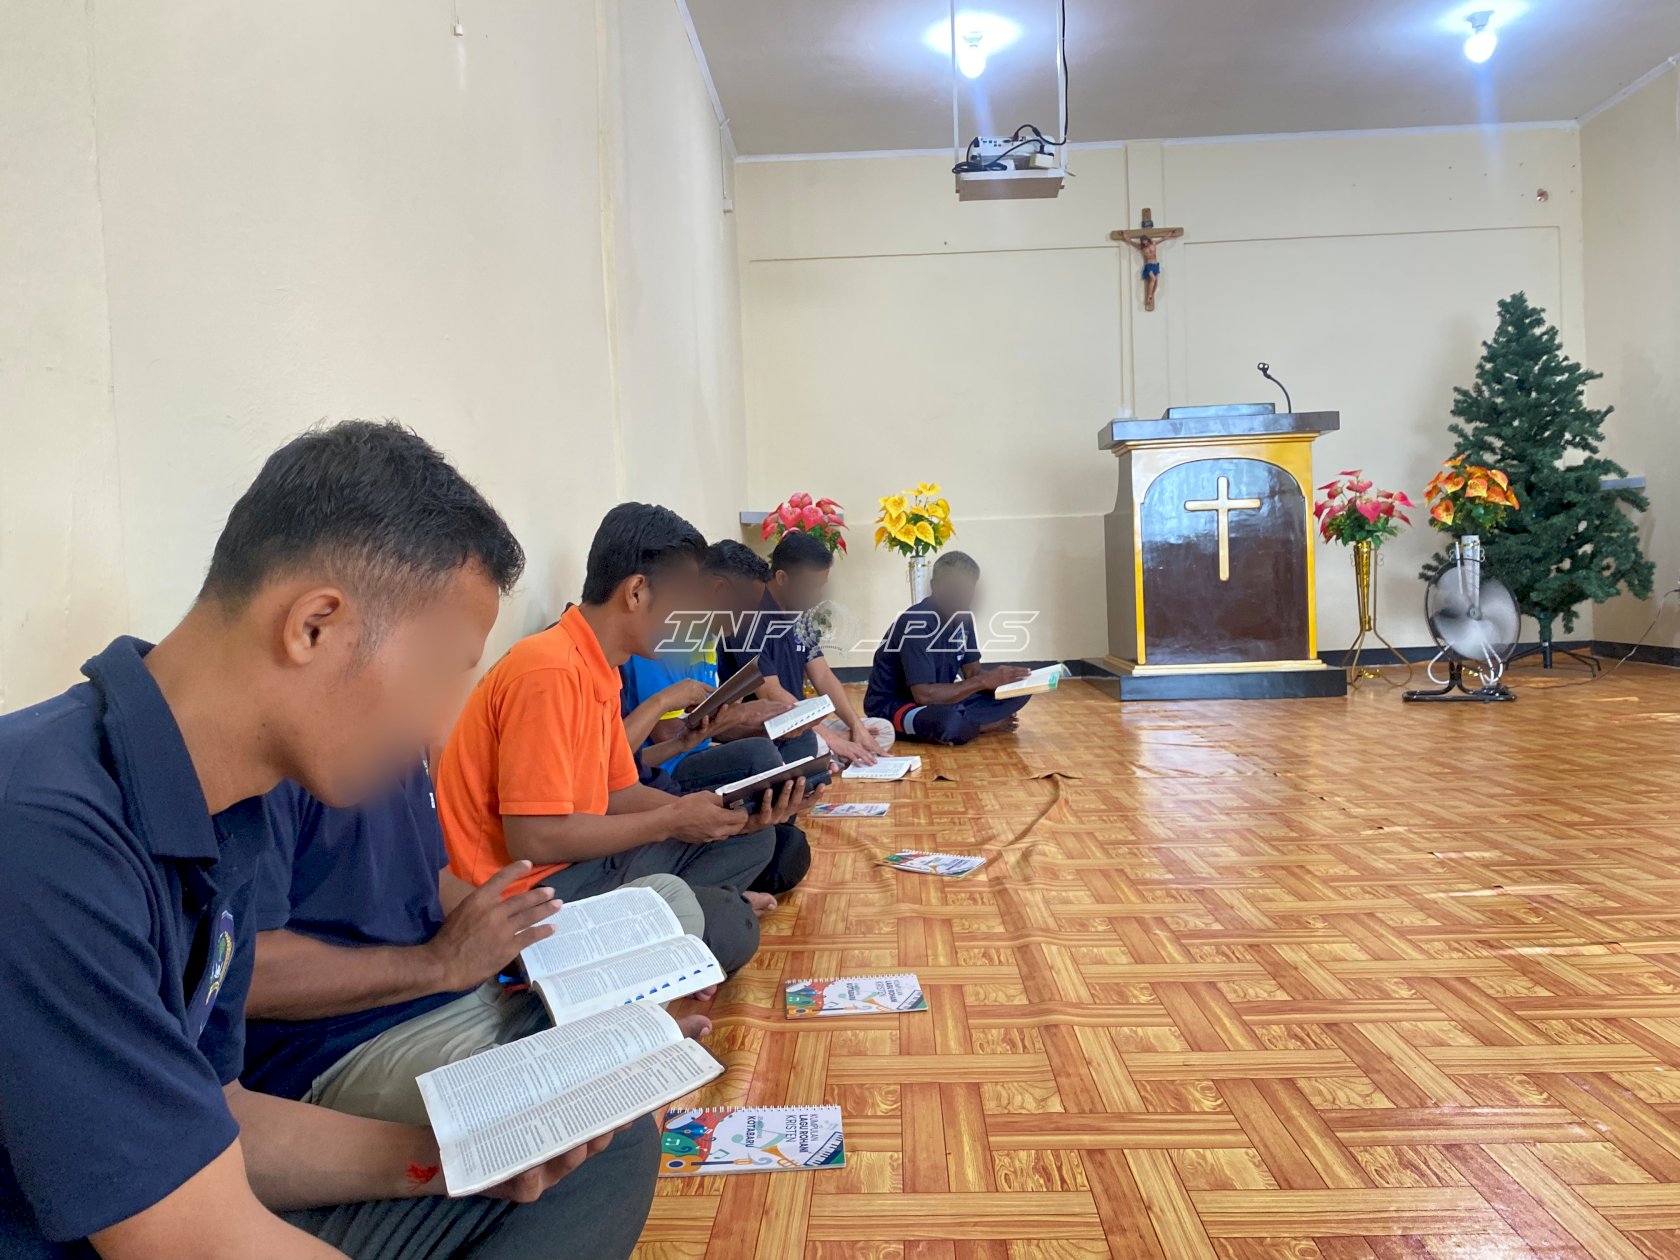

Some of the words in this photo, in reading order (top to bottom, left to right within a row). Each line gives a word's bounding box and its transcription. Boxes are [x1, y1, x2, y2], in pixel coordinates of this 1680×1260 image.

[745, 1115, 756, 1148] KOTABARU
[785, 1114, 797, 1143] KRISTEN
[799, 1114, 808, 1131] LAGU
[809, 1113, 819, 1142] KUMPULAN
[799, 1131, 809, 1153] ROHANI
